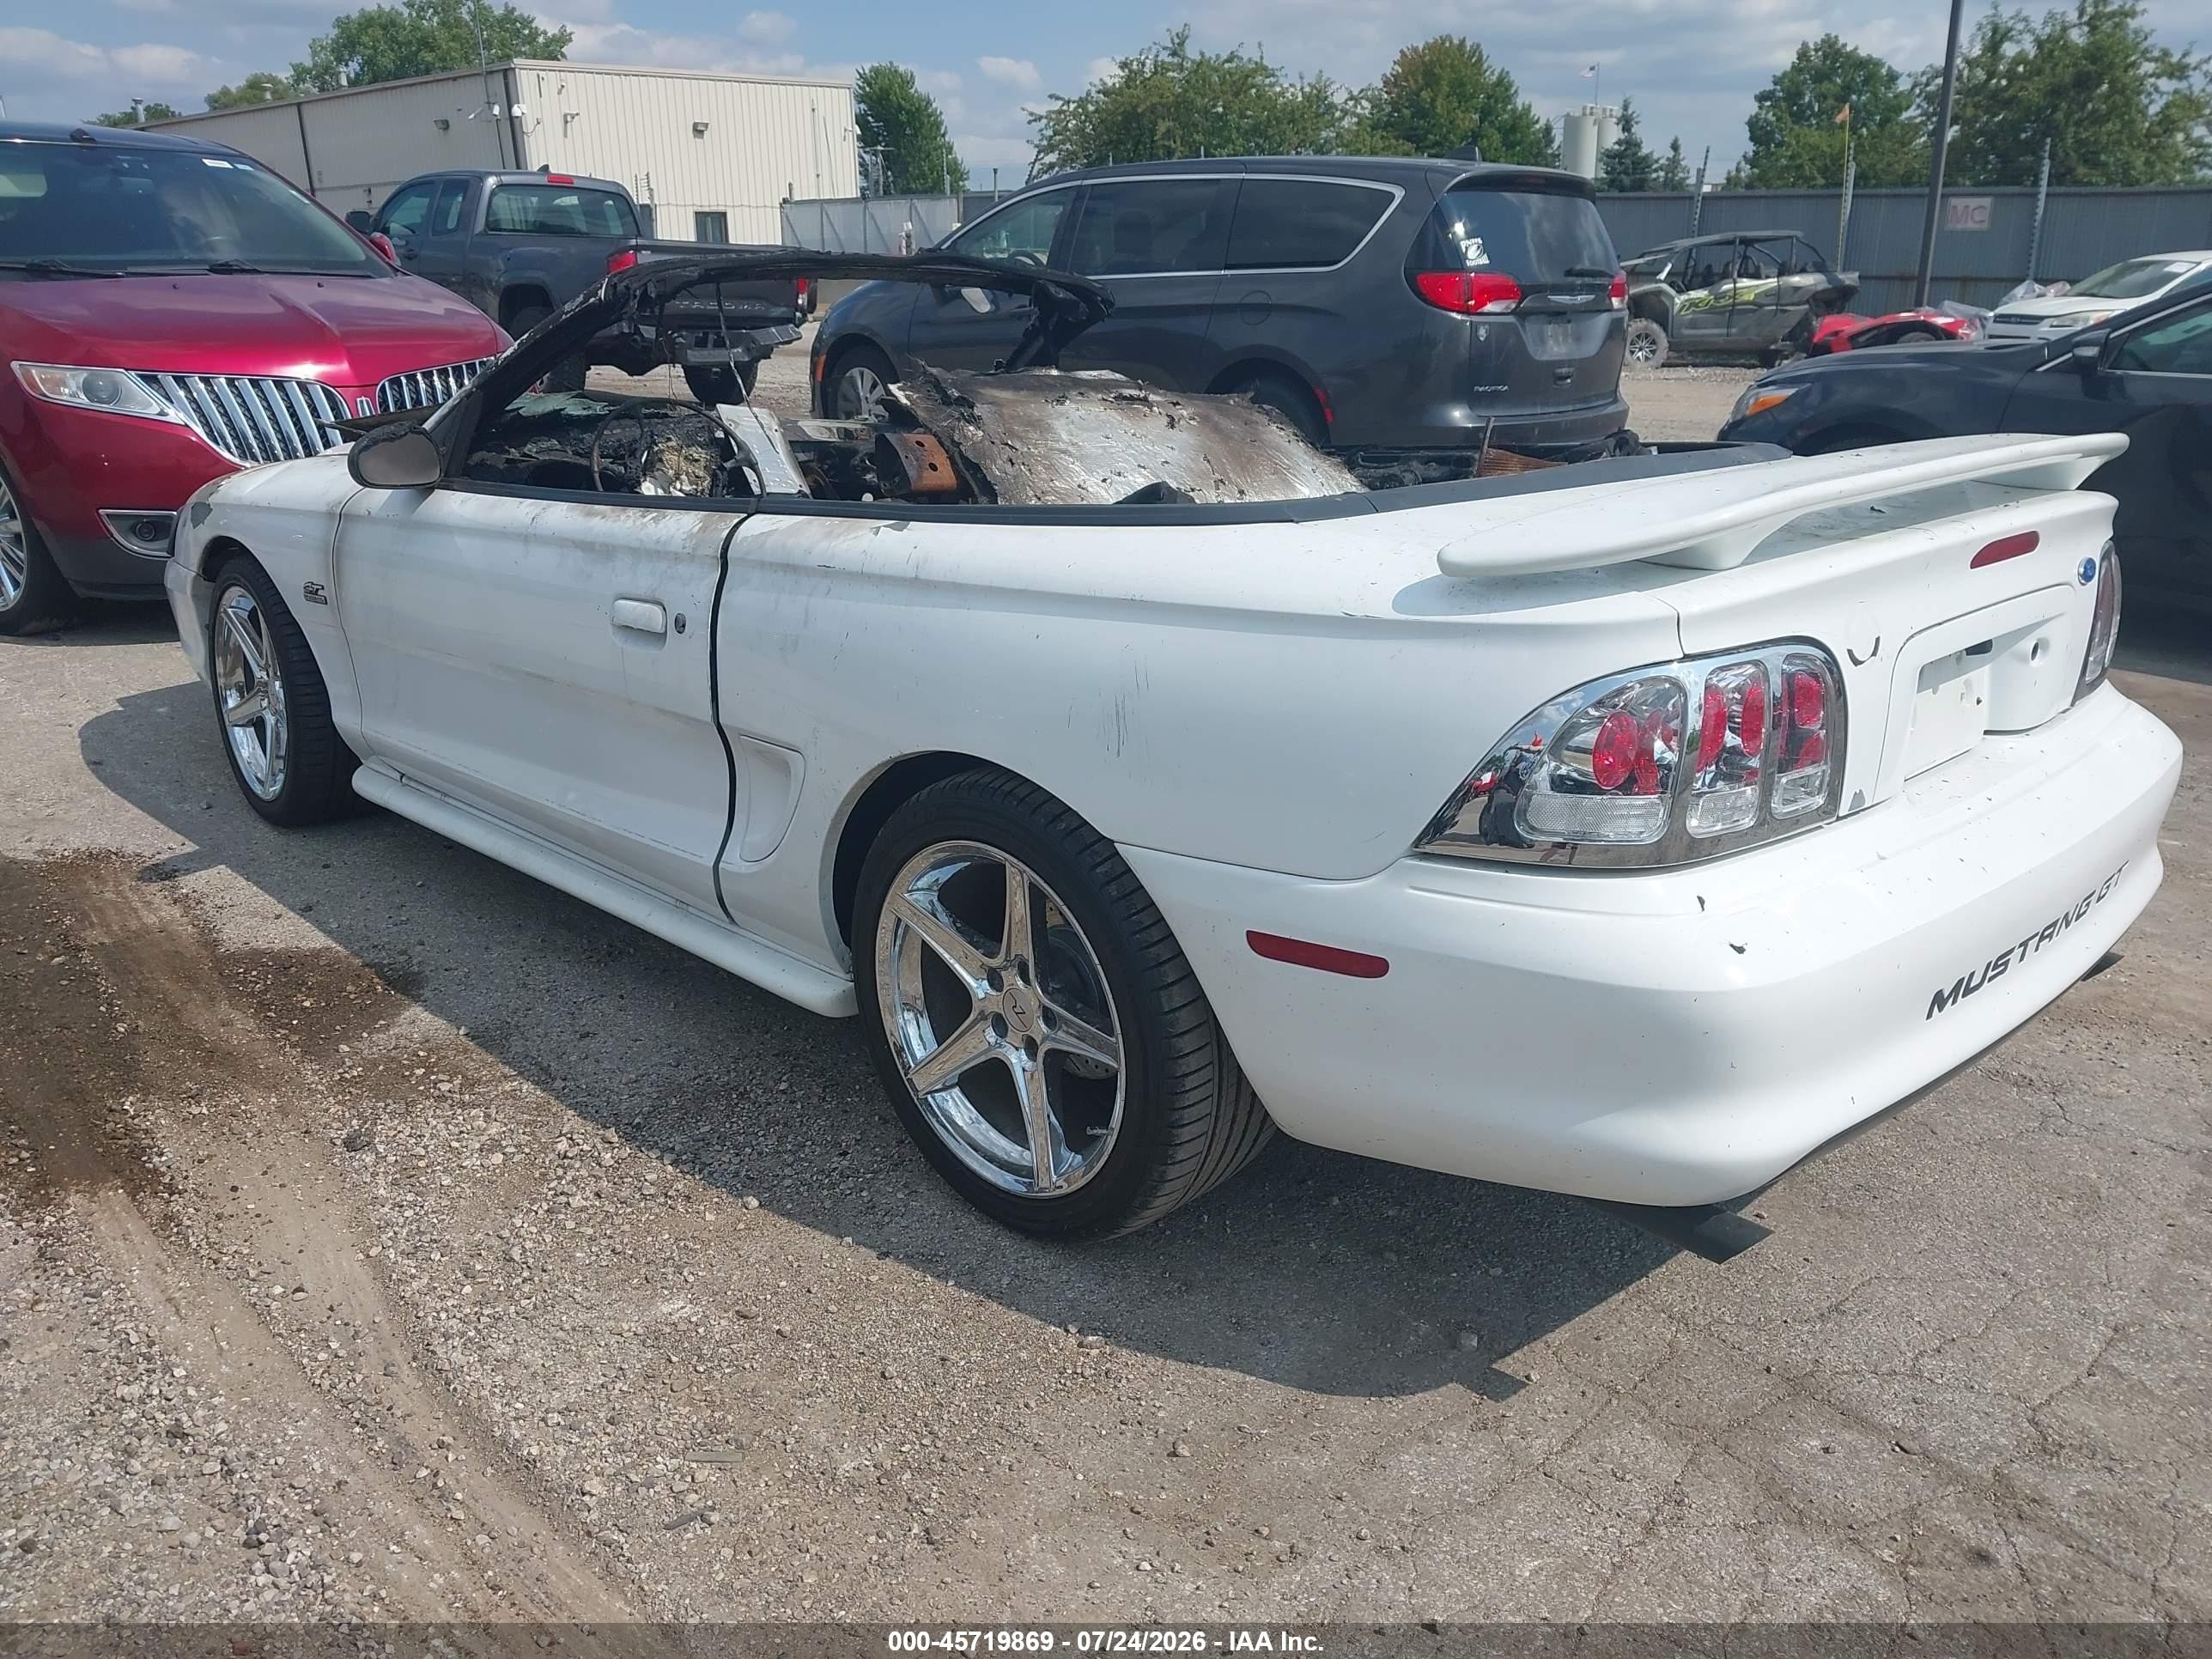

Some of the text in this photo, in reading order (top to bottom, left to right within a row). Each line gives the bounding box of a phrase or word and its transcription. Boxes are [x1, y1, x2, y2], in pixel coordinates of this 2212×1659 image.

[1950, 204, 1987, 225] MC
[1925, 859, 2130, 1020] MUSTANG GT
